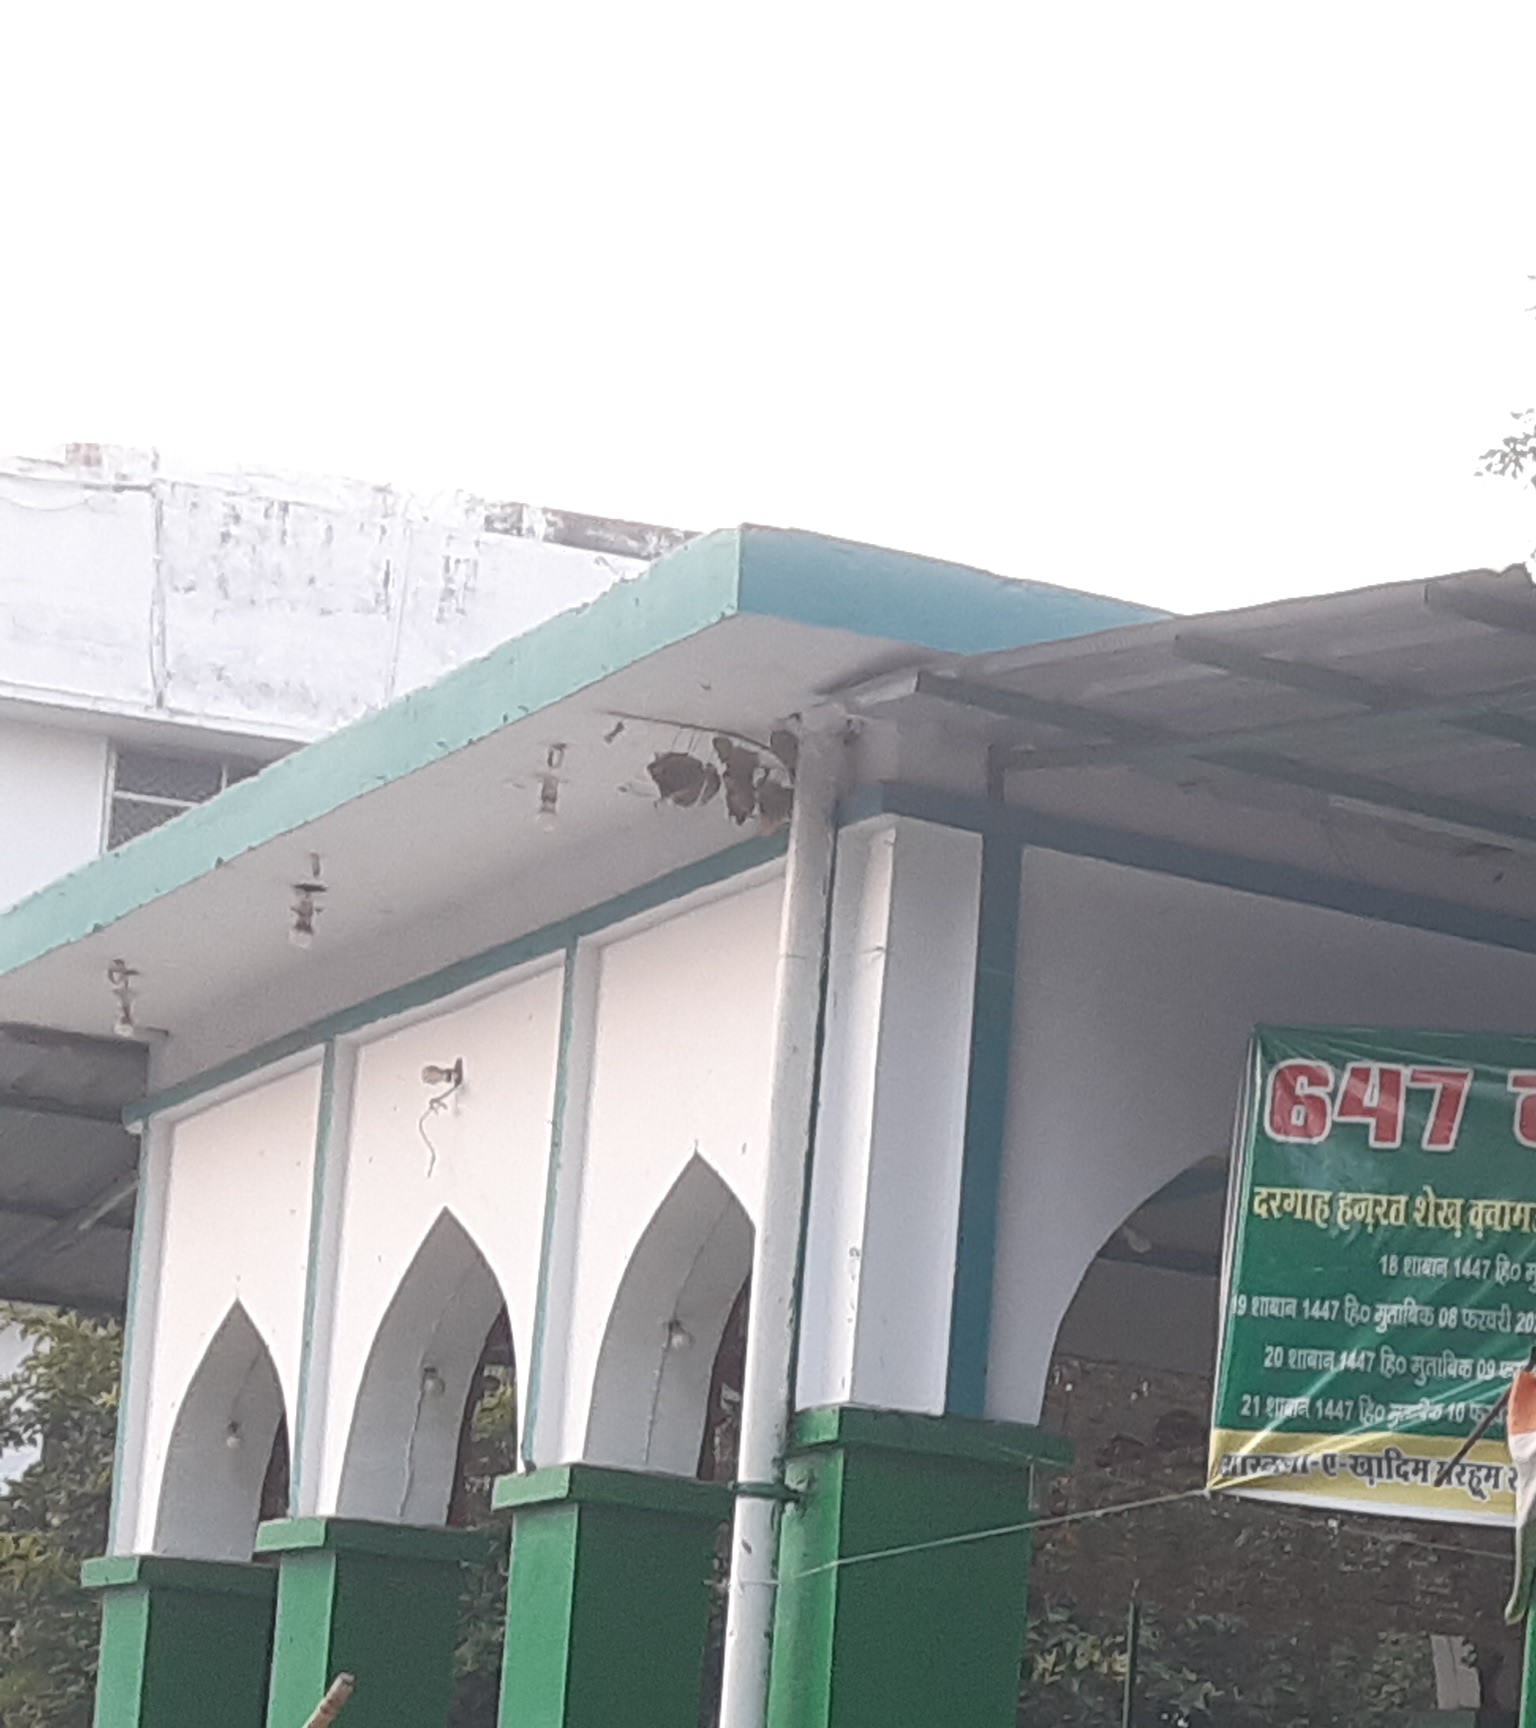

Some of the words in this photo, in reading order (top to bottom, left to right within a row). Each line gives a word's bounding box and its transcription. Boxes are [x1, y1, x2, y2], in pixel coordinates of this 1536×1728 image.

[1264, 1058, 1474, 1151] 647
[1253, 1186, 1333, 1230] दरगाह
[1379, 1254, 1400, 1277] 18
[1452, 1260, 1490, 1281] 1447
[1302, 1298, 1341, 1319] 1447
[1437, 1305, 1458, 1329] 08
[1263, 1345, 1284, 1369] 20
[1339, 1351, 1376, 1372] 1447
[1476, 1361, 1497, 1383] 09
[1240, 1394, 1261, 1417] 21
[1316, 1400, 1353, 1421] 1447
[1447, 1401, 1466, 1424] 10
